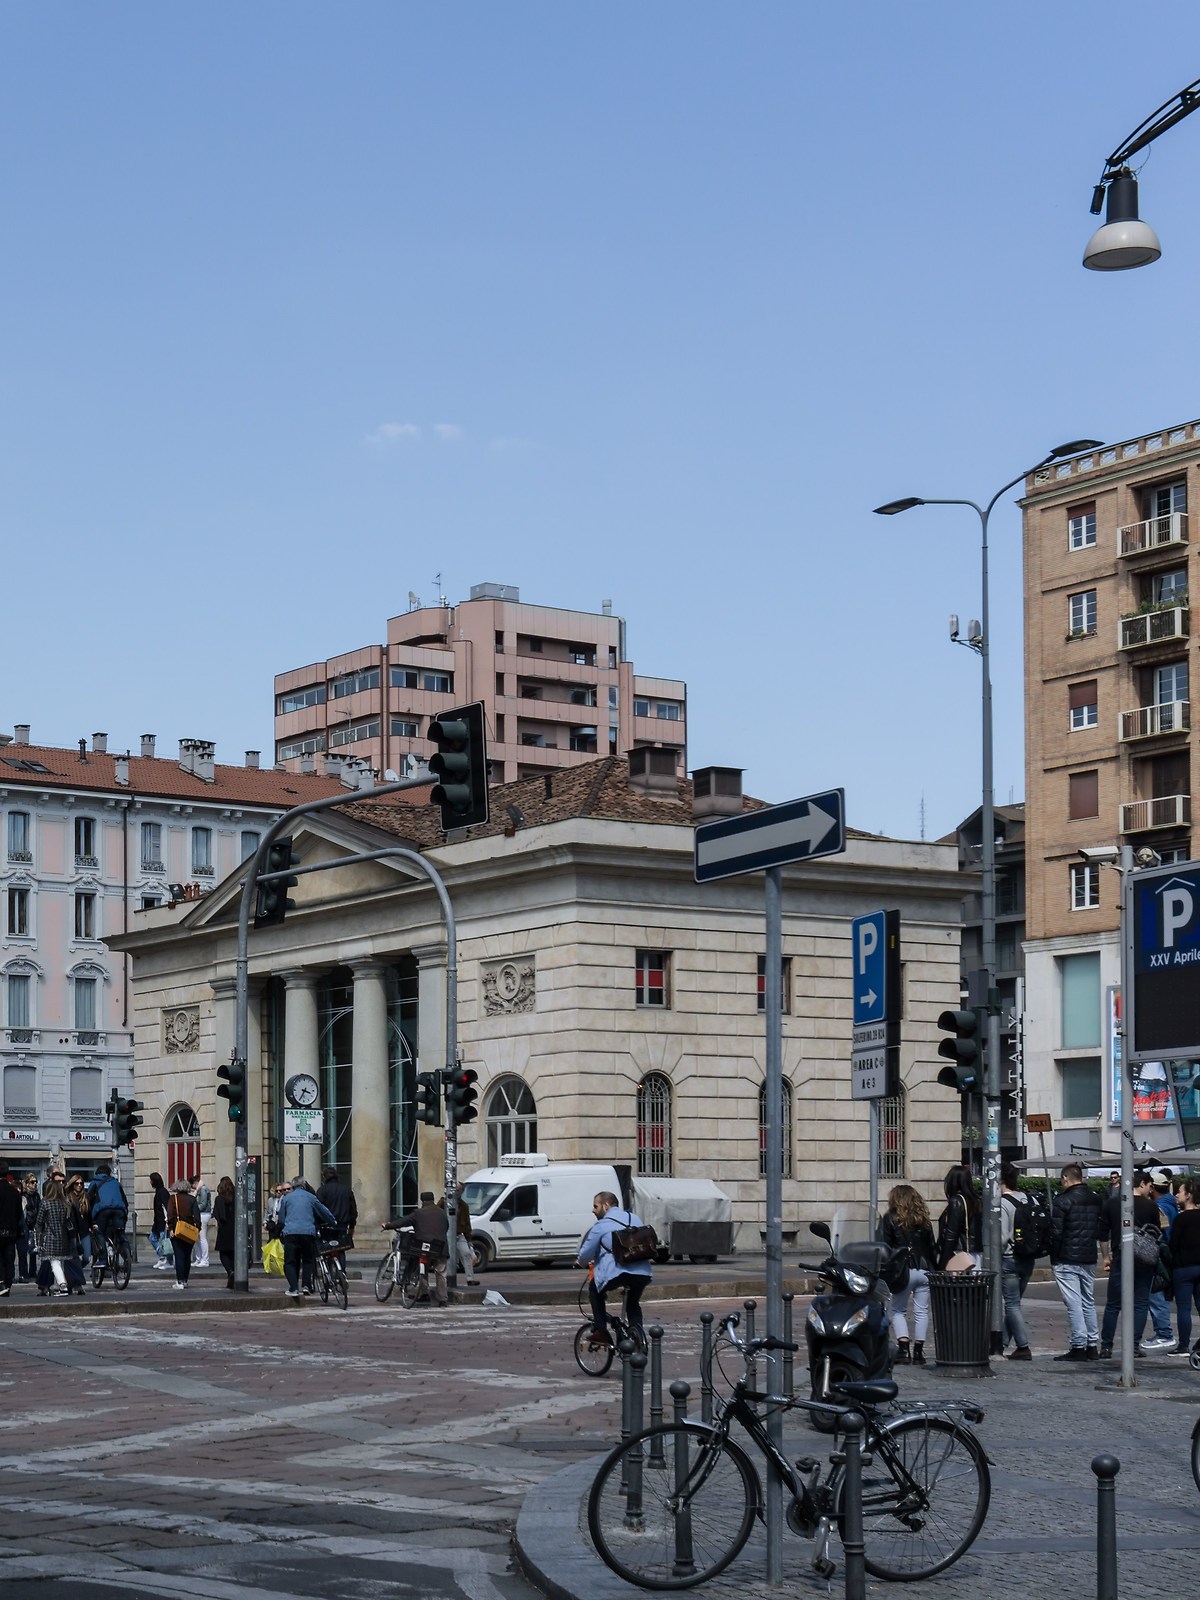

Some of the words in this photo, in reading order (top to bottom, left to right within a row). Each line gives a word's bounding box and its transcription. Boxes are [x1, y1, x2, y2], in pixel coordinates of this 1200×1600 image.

[1163, 888, 1193, 947] P
[859, 922, 878, 975] P
[1150, 953, 1170, 967] XXV
[1174, 948, 1200, 964] Aprile
[859, 1058, 873, 1071] AREA
